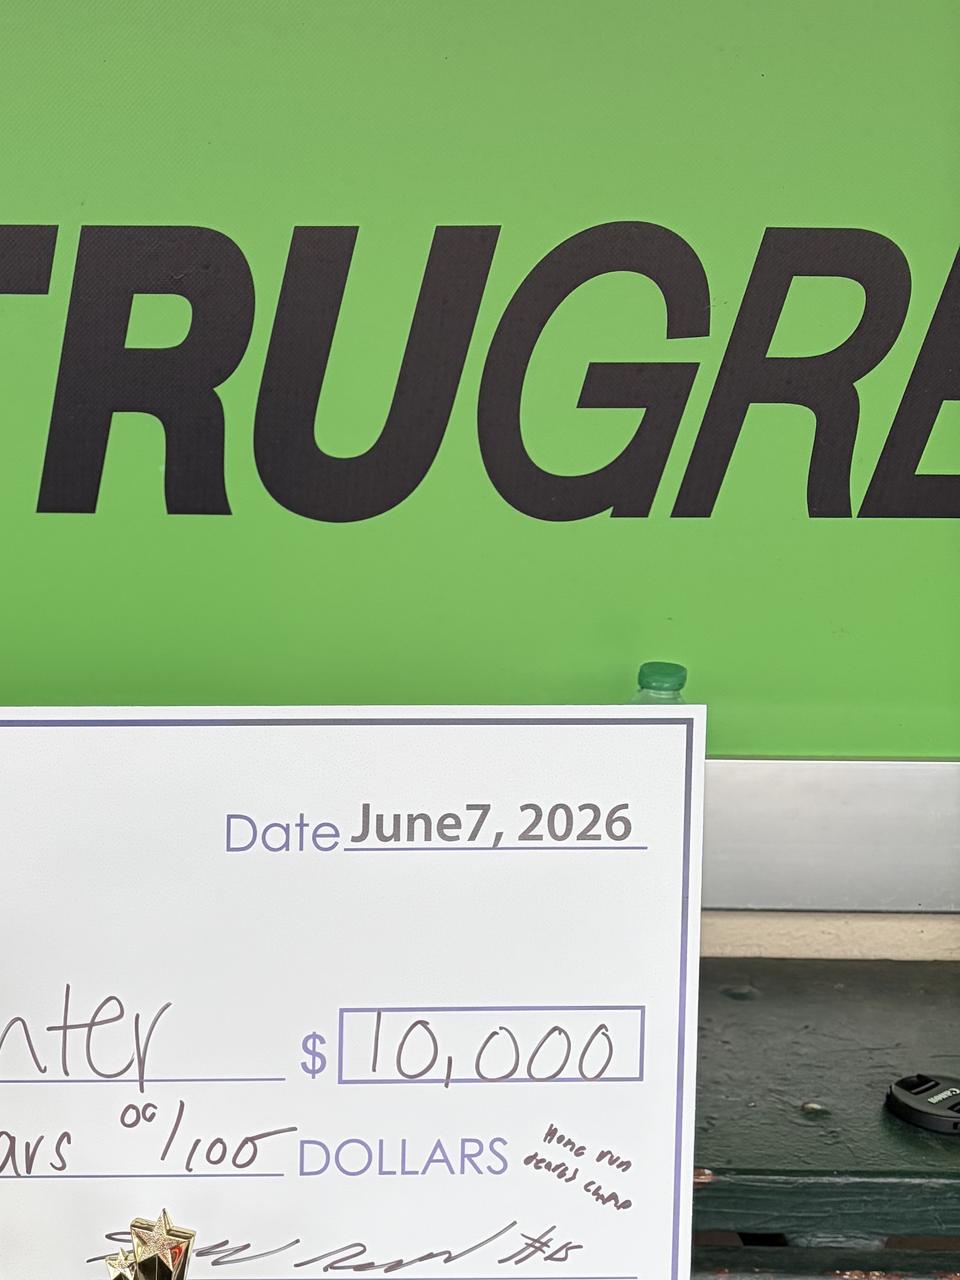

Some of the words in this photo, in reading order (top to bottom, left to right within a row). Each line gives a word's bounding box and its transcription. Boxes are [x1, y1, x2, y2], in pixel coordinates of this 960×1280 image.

[226, 813, 339, 852] Date
[518, 803, 632, 841] 2026
[301, 1032, 326, 1079] $
[372, 1010, 613, 1088] 10,000
[300, 1137, 508, 1176] DOLLARS
